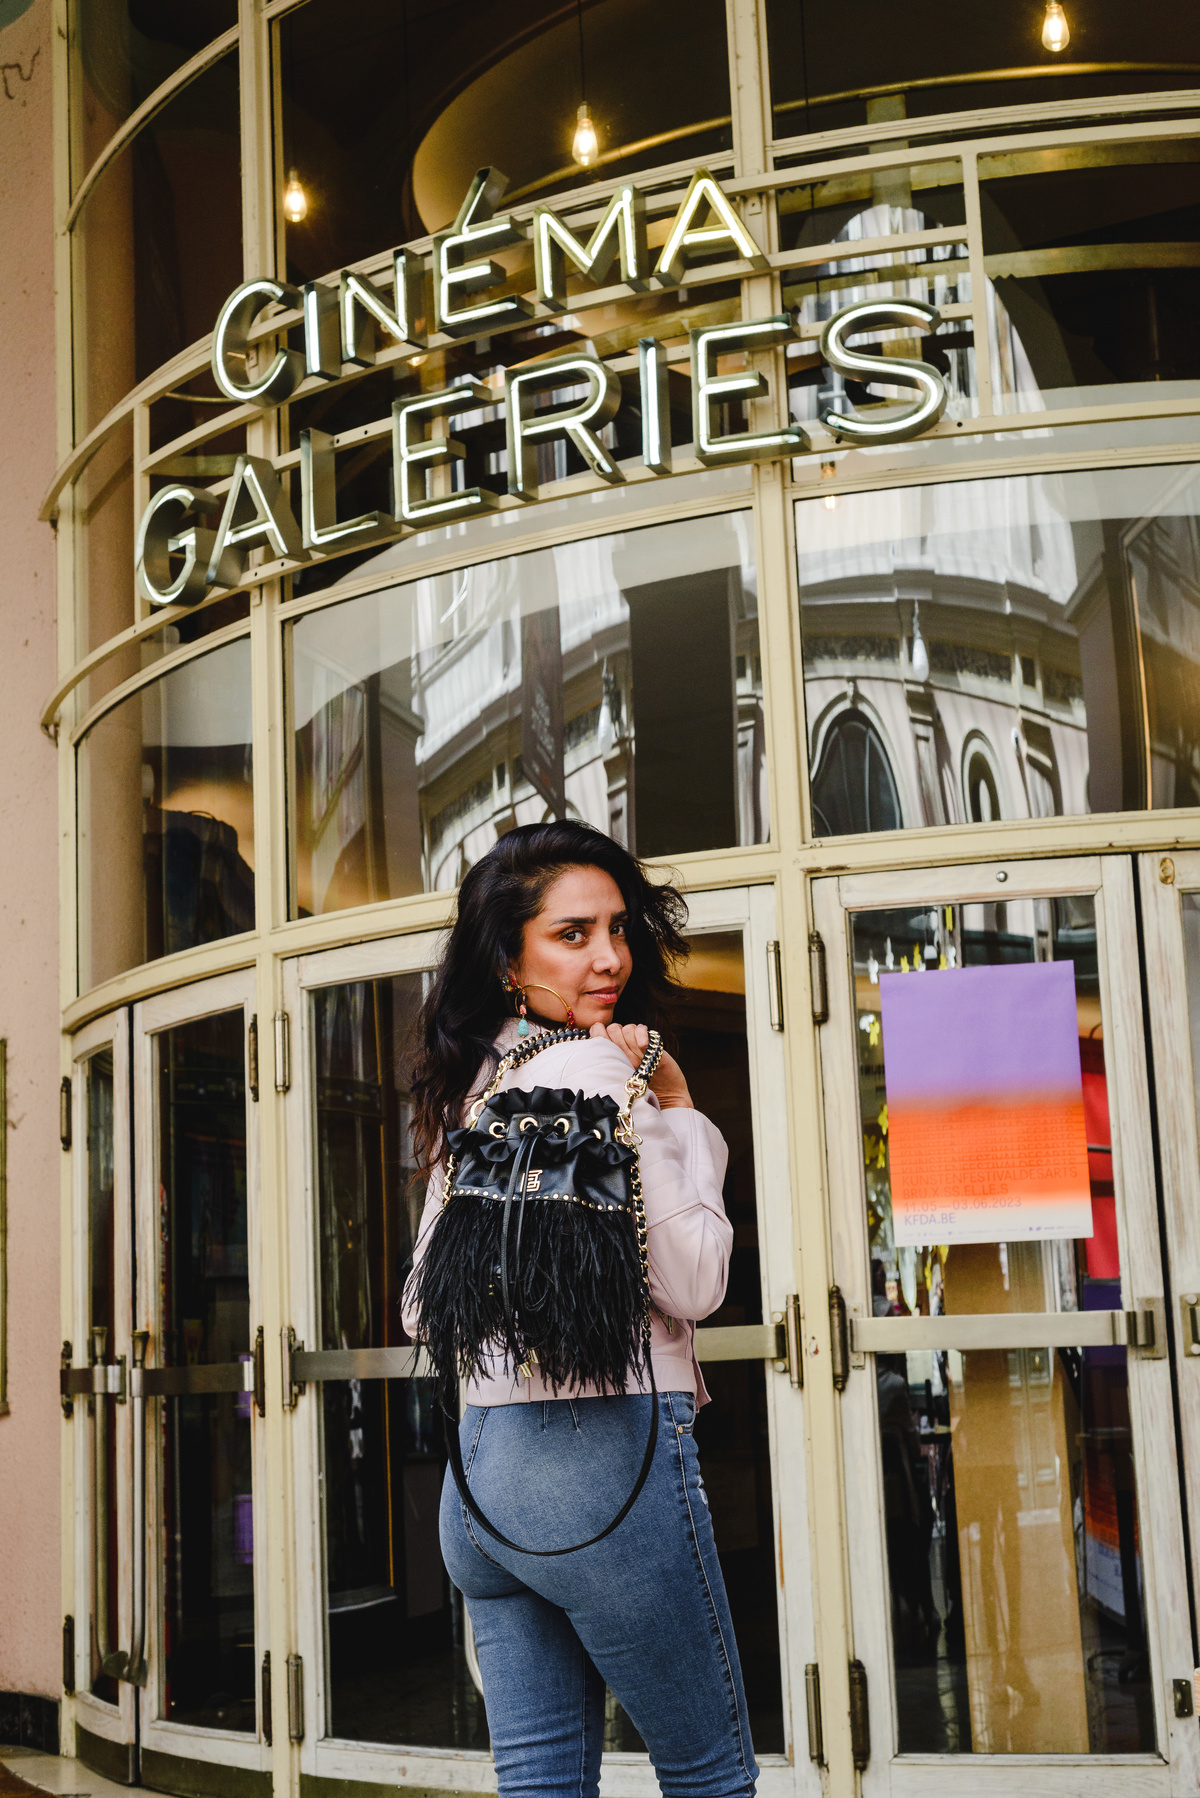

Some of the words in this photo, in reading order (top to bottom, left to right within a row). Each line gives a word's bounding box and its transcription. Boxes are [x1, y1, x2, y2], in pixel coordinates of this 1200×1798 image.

[211, 167, 769, 404] CINÉMA
[135, 297, 947, 606] GALERIES
[902, 1166, 1078, 1187] KUNSTENFESTIVALDESARTS
[904, 1212, 957, 1226] KFDA.BE
